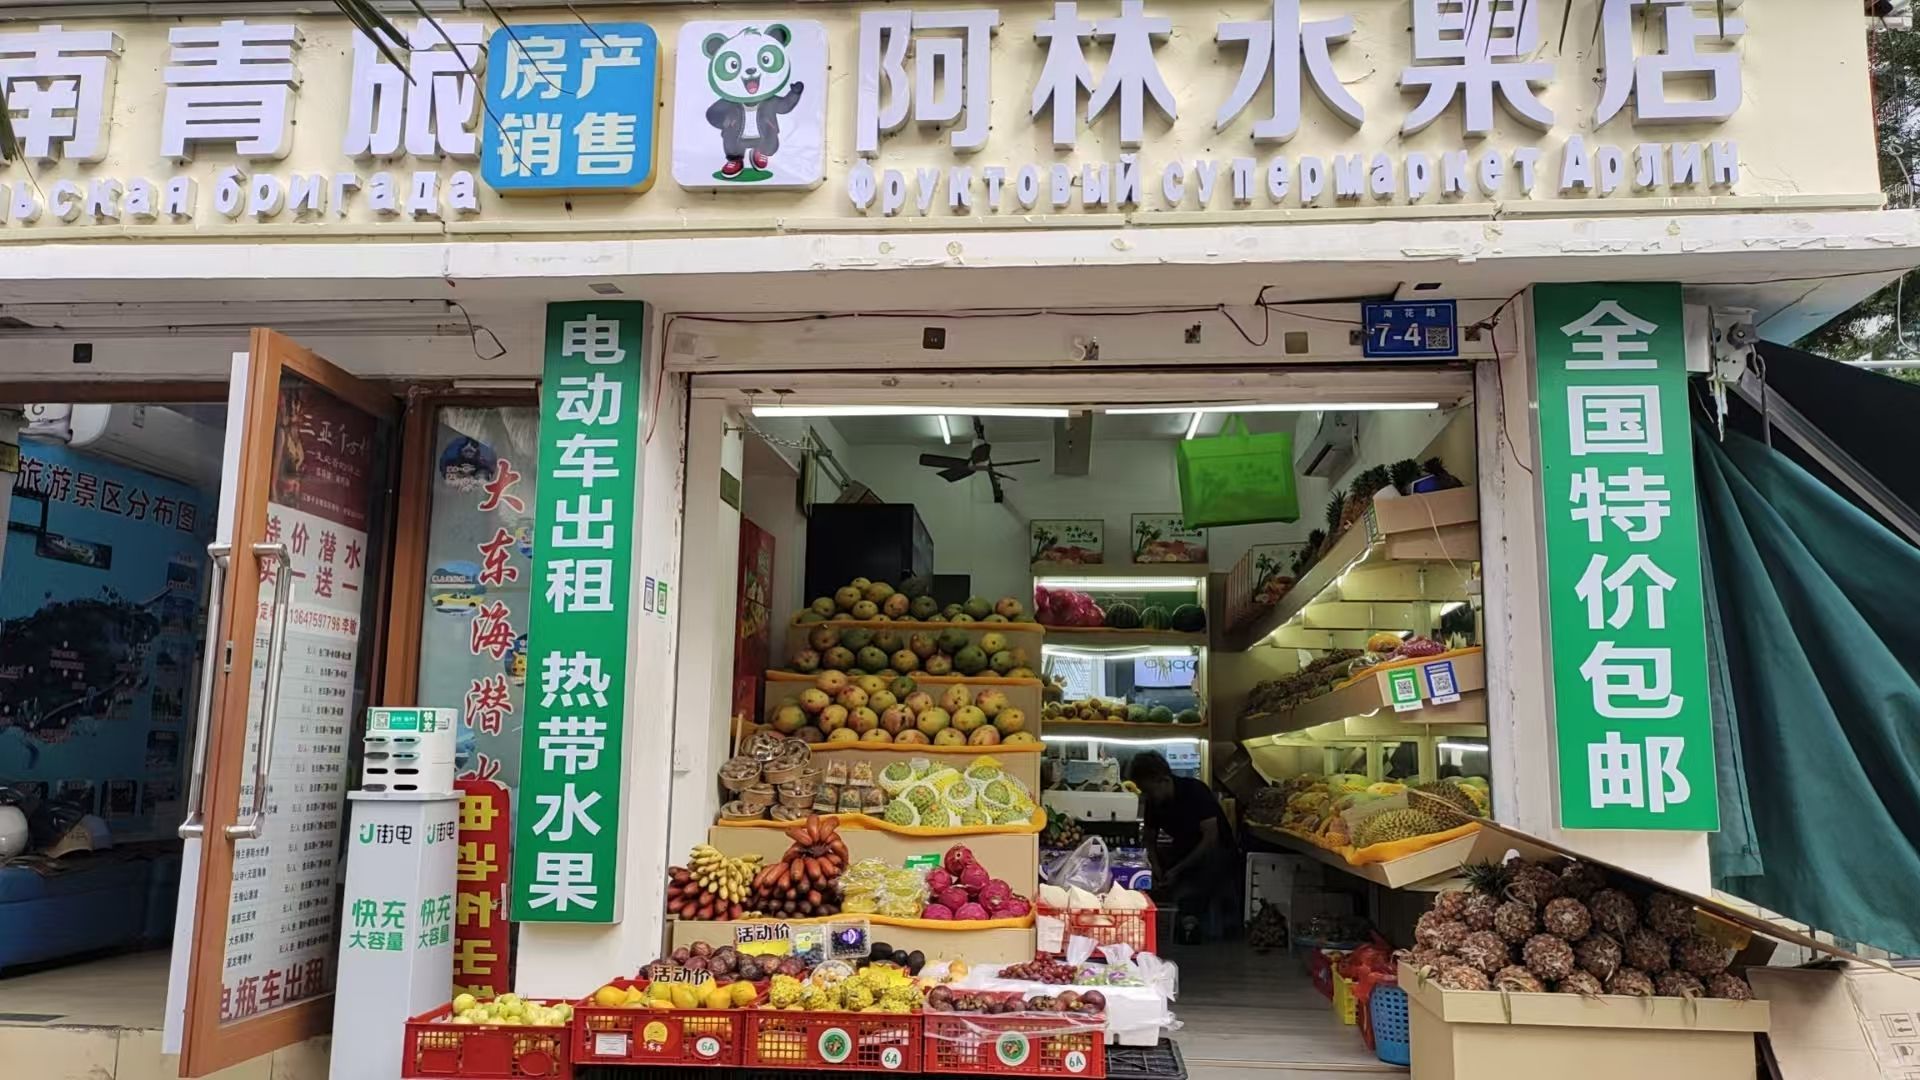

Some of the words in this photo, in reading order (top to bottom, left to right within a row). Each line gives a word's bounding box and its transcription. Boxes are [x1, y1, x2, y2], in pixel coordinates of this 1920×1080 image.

[0, 18, 488, 160] 南青旅
[501, 33, 643, 100] 房产
[856, 0, 1746, 154] 阿林水果店
[496, 112, 637, 178] 销售
[848, 152, 1144, 215] Фруктовый
[1162, 145, 1541, 208] супермаркет
[1558, 135, 1742, 197] Арлин
[0, 174, 196, 224] ьская
[214, 165, 482, 219] бригада
[1375, 322, 1422, 348] 7-4
[15, 455, 197, 533] 旅游景区分布图
[543, 313, 627, 615] 电动车出租
[1559, 300, 1691, 814] 全国特价包邮
[527, 649, 611, 913] 热带水果
[376, 823, 413, 845] 街电
[351, 899, 407, 929] 快充
[420, 894, 451, 926] 快充
[454, 794, 500, 998] 电动车出
[348, 930, 403, 951] 大容量
[417, 924, 450, 949] 大容量
[737, 923, 791, 942] 活动价
[652, 966, 713, 985] 活动价
[883, 1053, 899, 1066] 6A
